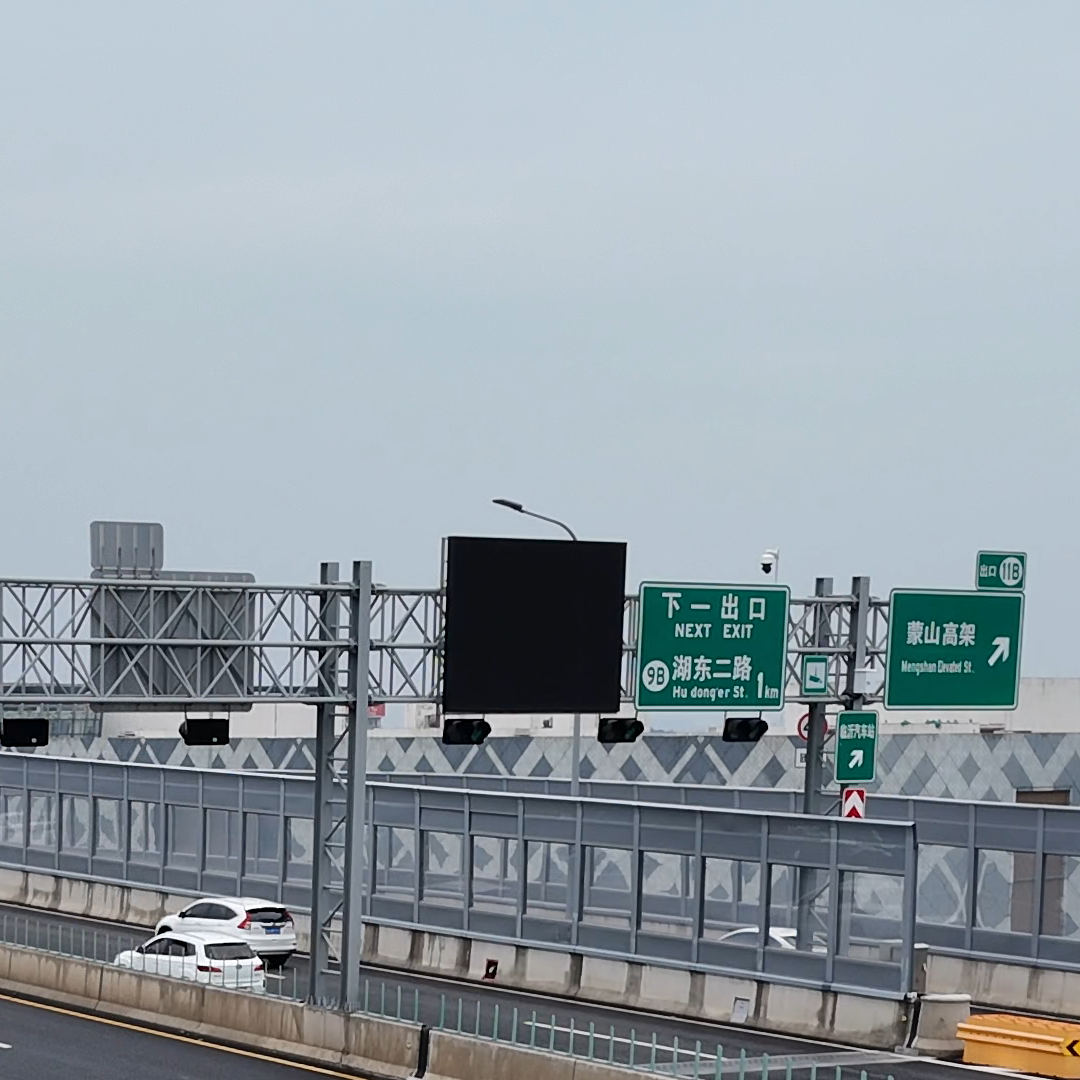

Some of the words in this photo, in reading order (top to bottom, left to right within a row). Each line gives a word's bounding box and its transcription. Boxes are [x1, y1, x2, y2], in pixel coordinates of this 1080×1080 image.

[980, 564, 997, 577] 出口
[1002, 562, 1020, 580] 11B
[661, 592, 766, 620] 下一出口
[675, 623, 712, 638] NEXT
[723, 623, 754, 639] EXIT
[906, 620, 976, 647] 蒙山高架
[647, 666, 665, 686] 9B
[672, 654, 752, 681] 湖东二路
[901, 660, 936, 676] Mengshan
[672, 685, 688, 698] Hu
[733, 685, 749, 699] St.
